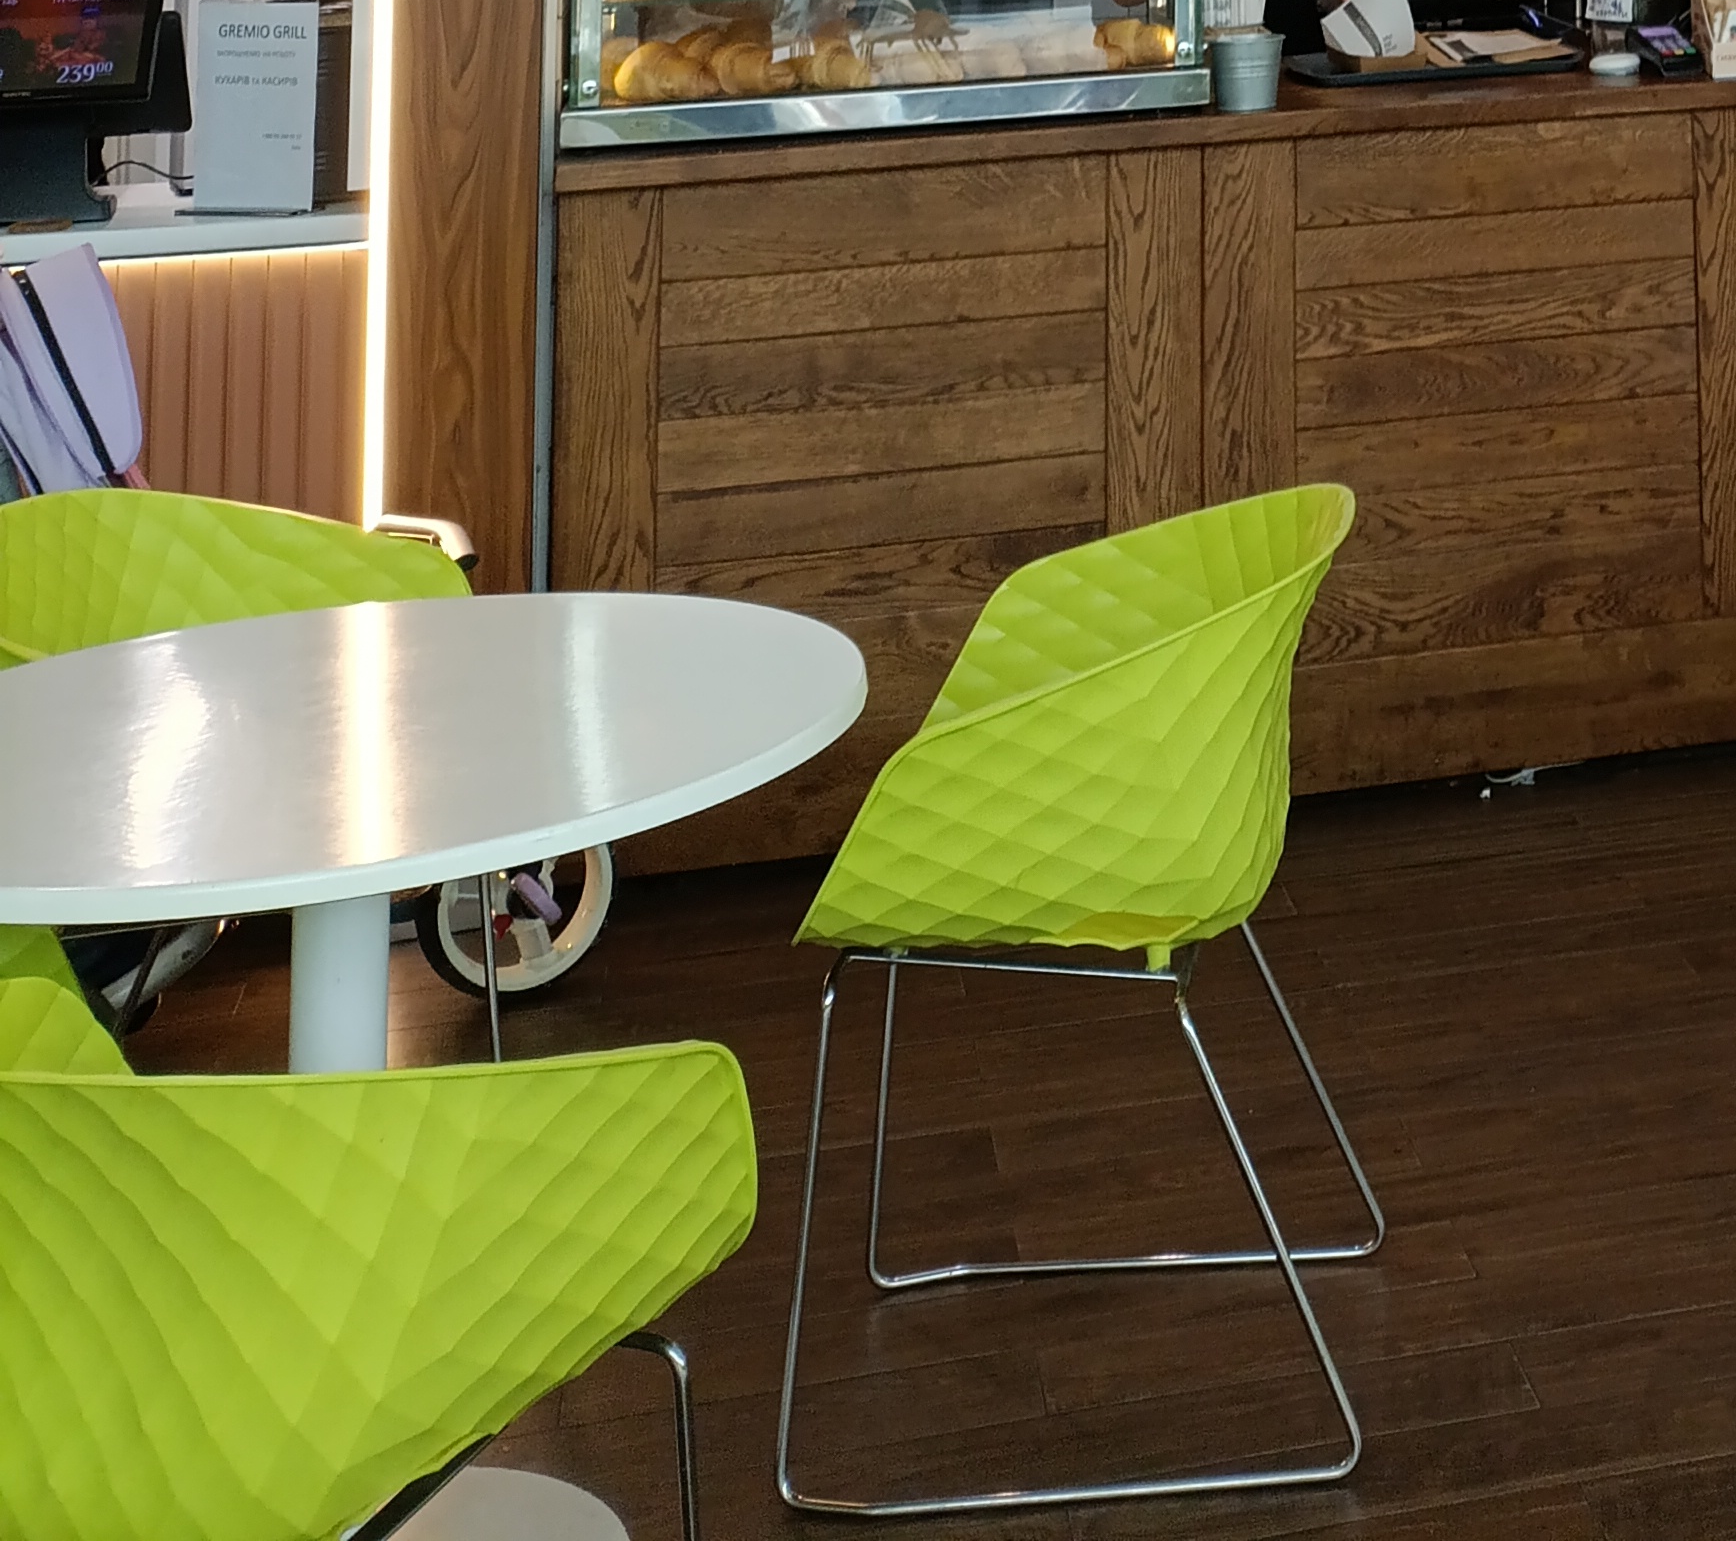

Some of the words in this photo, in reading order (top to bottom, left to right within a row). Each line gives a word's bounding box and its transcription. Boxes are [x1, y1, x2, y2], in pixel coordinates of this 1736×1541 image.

[218, 23, 270, 39] GREMIO
[273, 25, 307, 39] GRILL
[56, 63, 96, 84] 239
[214, 75, 250, 85] КУХАРІВ
